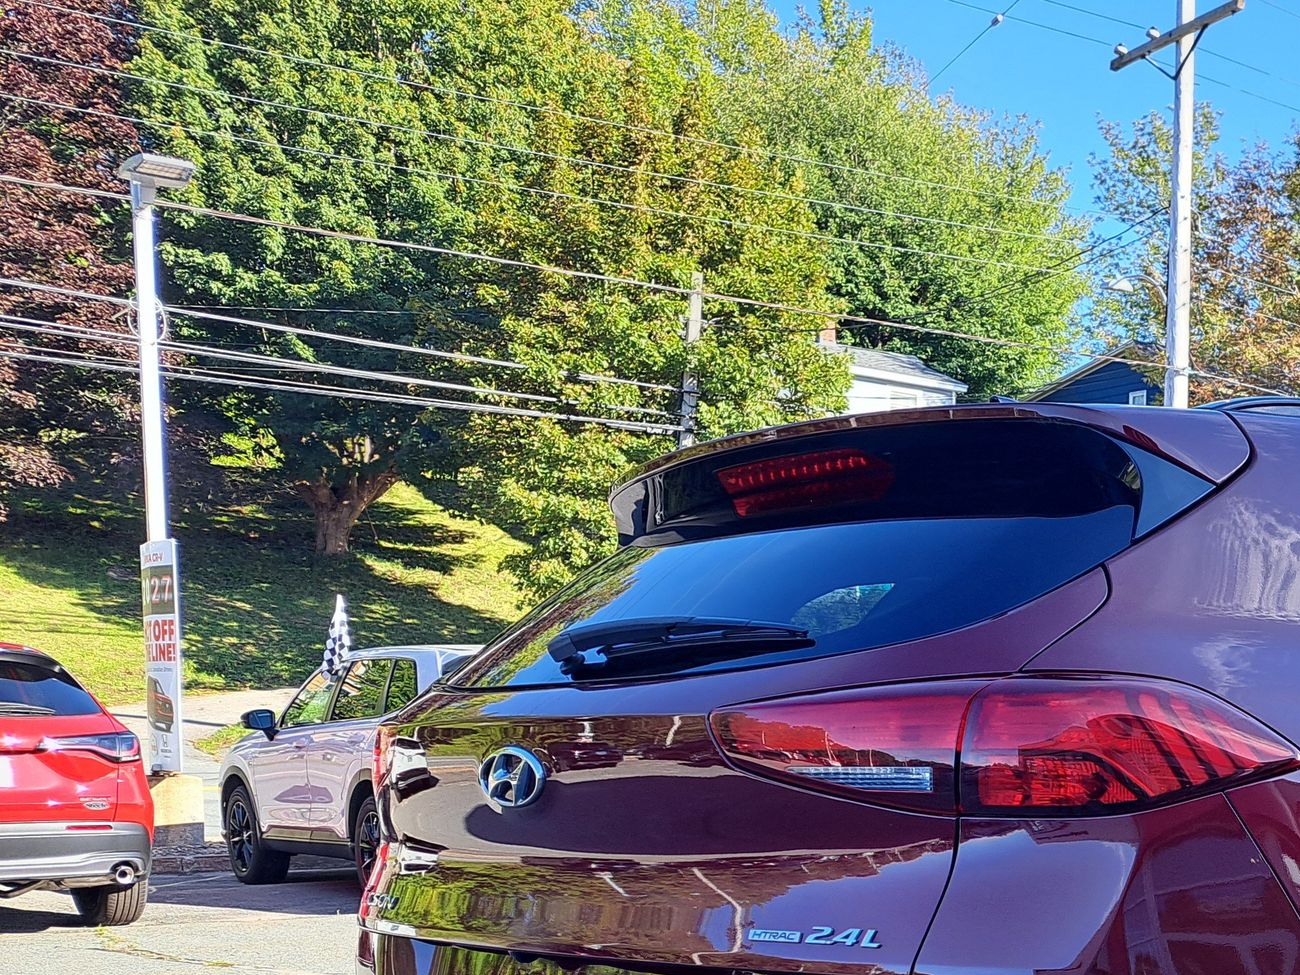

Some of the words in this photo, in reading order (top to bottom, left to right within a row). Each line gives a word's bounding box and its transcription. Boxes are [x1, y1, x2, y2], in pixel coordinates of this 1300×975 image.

[153, 619, 174, 642] OFF
[151, 642, 176, 662] LINE!
[752, 930, 796, 941] HTRAC
[805, 926, 882, 949] 2.4L
